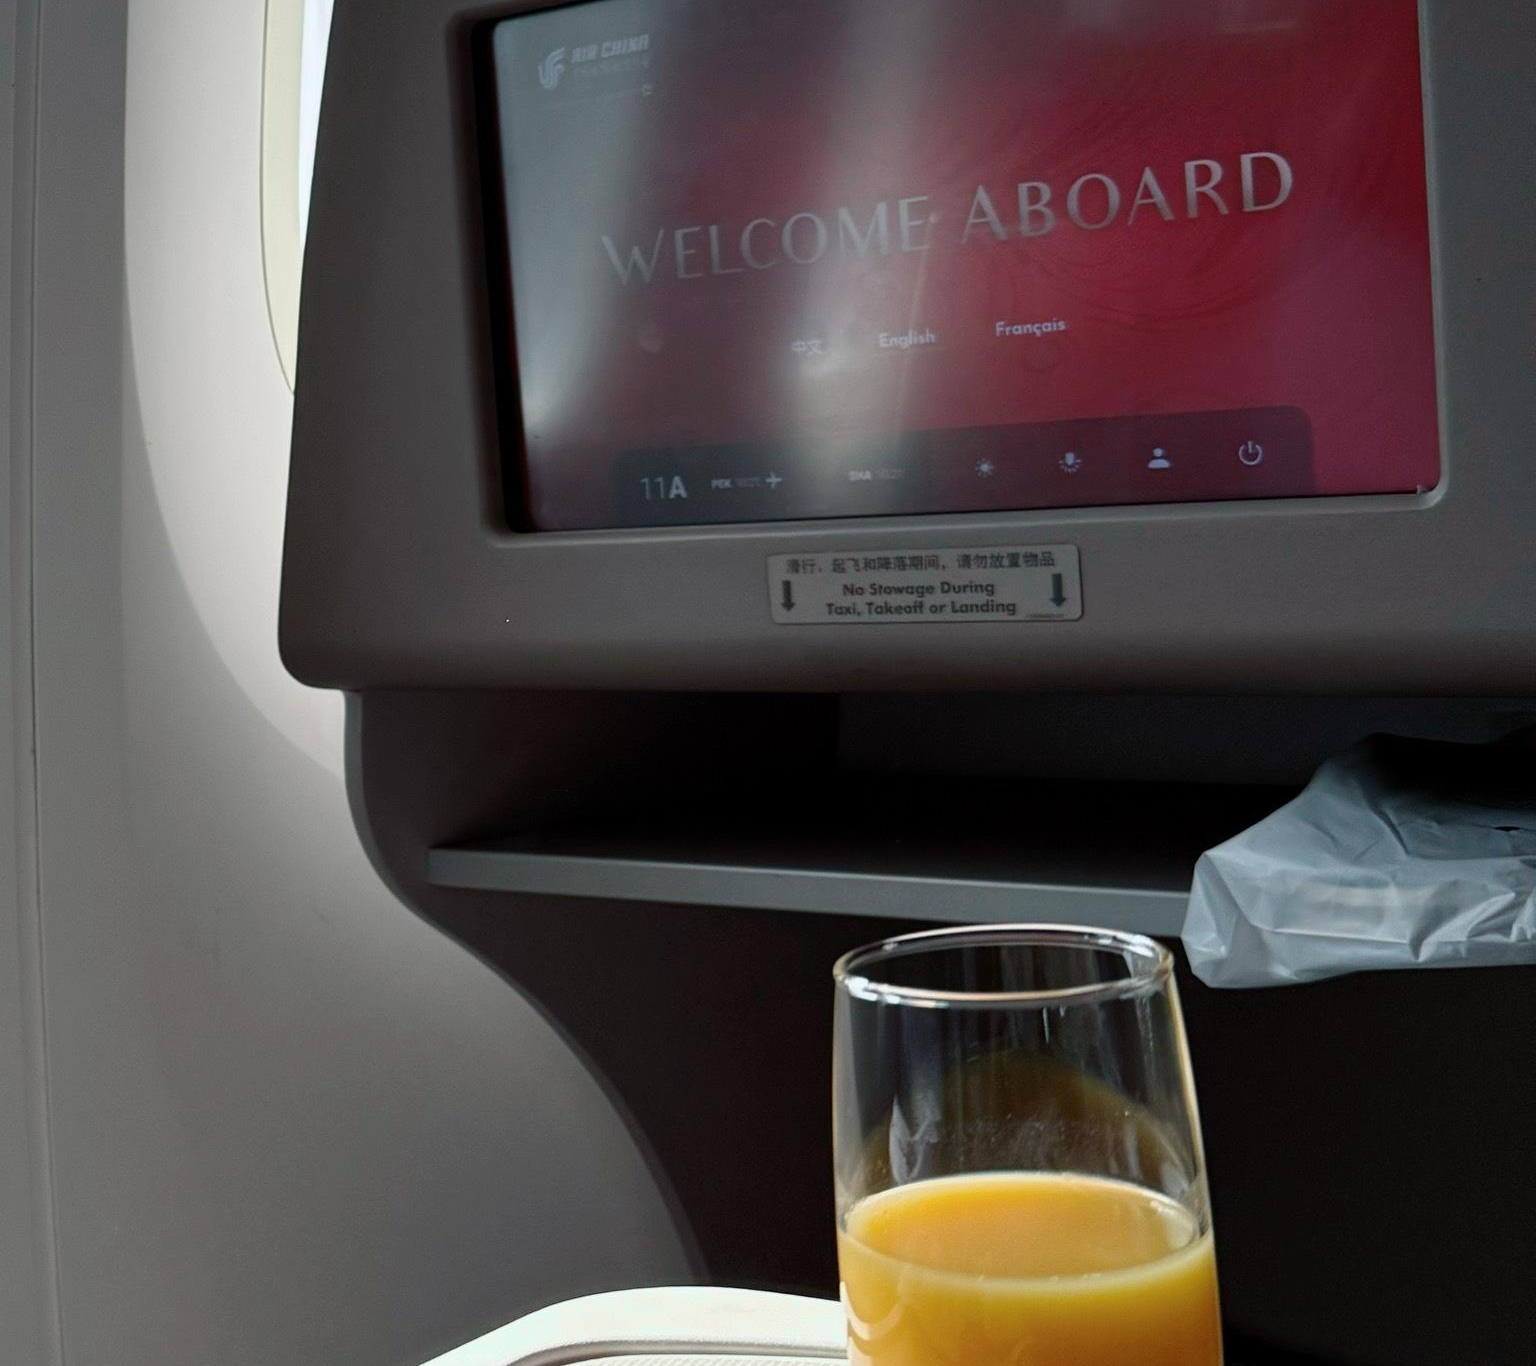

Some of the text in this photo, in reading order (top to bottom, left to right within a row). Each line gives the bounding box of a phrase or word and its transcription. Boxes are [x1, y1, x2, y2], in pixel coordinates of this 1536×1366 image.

[601, 34, 650, 58] CHINA
[602, 151, 1293, 286] WELCOME ABOARD
[995, 317, 1068, 338] Français
[878, 328, 936, 349] English
[639, 475, 688, 501] 11A
[842, 581, 995, 598] No Stowage During
[825, 600, 1017, 617] Taxi, Takeoff or Landing
